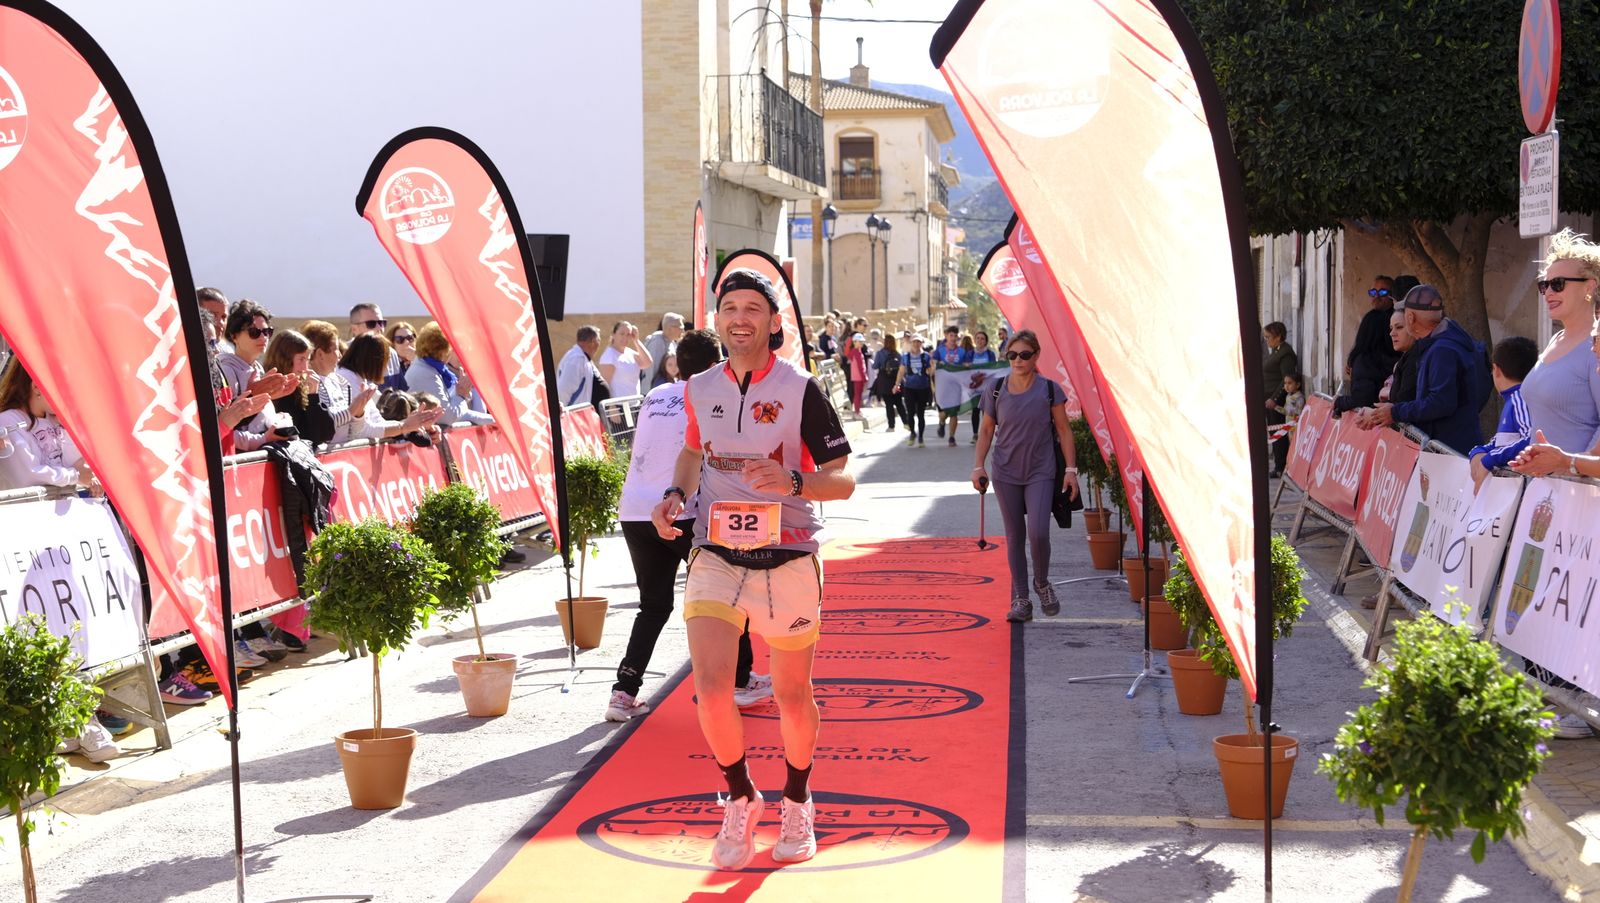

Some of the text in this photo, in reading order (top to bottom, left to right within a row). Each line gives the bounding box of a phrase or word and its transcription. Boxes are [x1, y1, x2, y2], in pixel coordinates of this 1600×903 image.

[728, 513, 759, 531] 32
[79, 538, 111, 562] DE
[867, 810, 921, 818] LA
